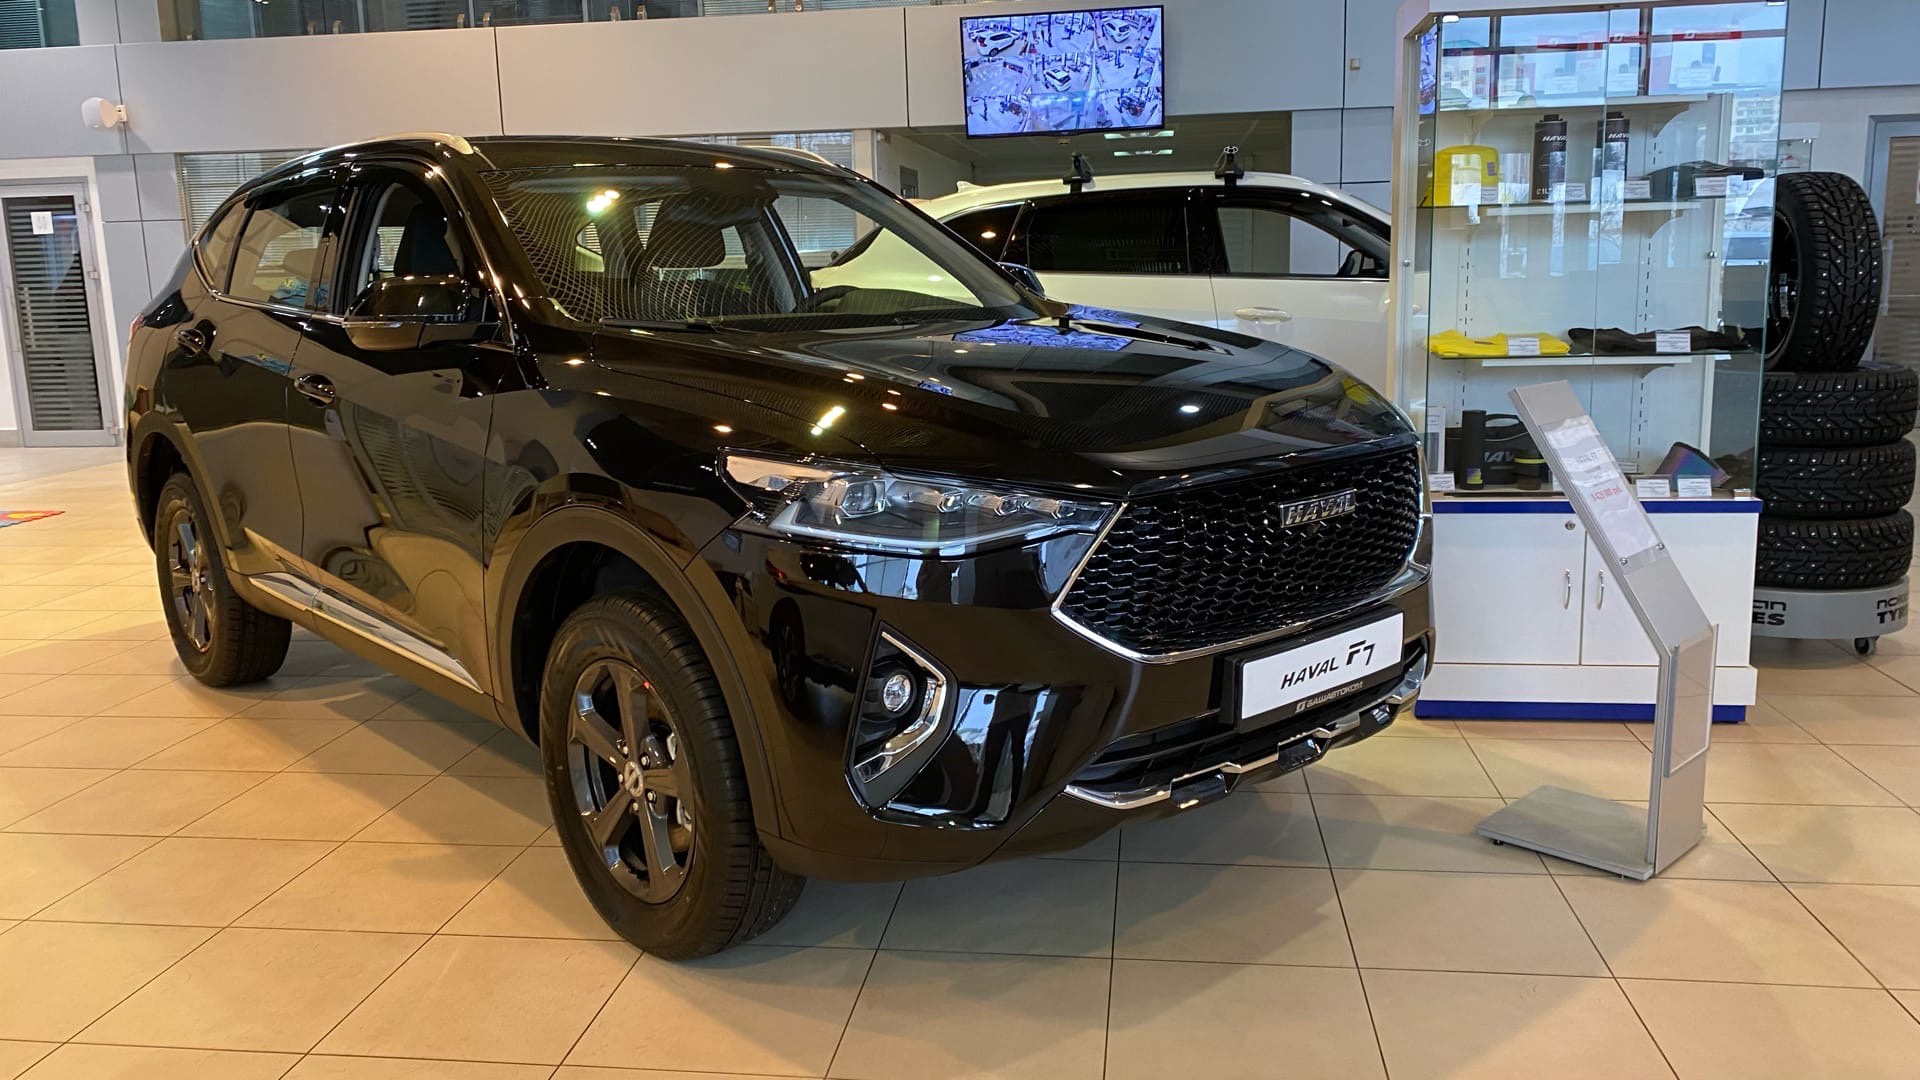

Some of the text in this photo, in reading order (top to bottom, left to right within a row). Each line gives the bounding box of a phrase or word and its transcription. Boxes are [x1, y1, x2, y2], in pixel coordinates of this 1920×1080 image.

[1285, 494, 1356, 525] HAVAL
[1752, 611, 1785, 626] ES
[1280, 640, 1375, 690] HAVAL F7
